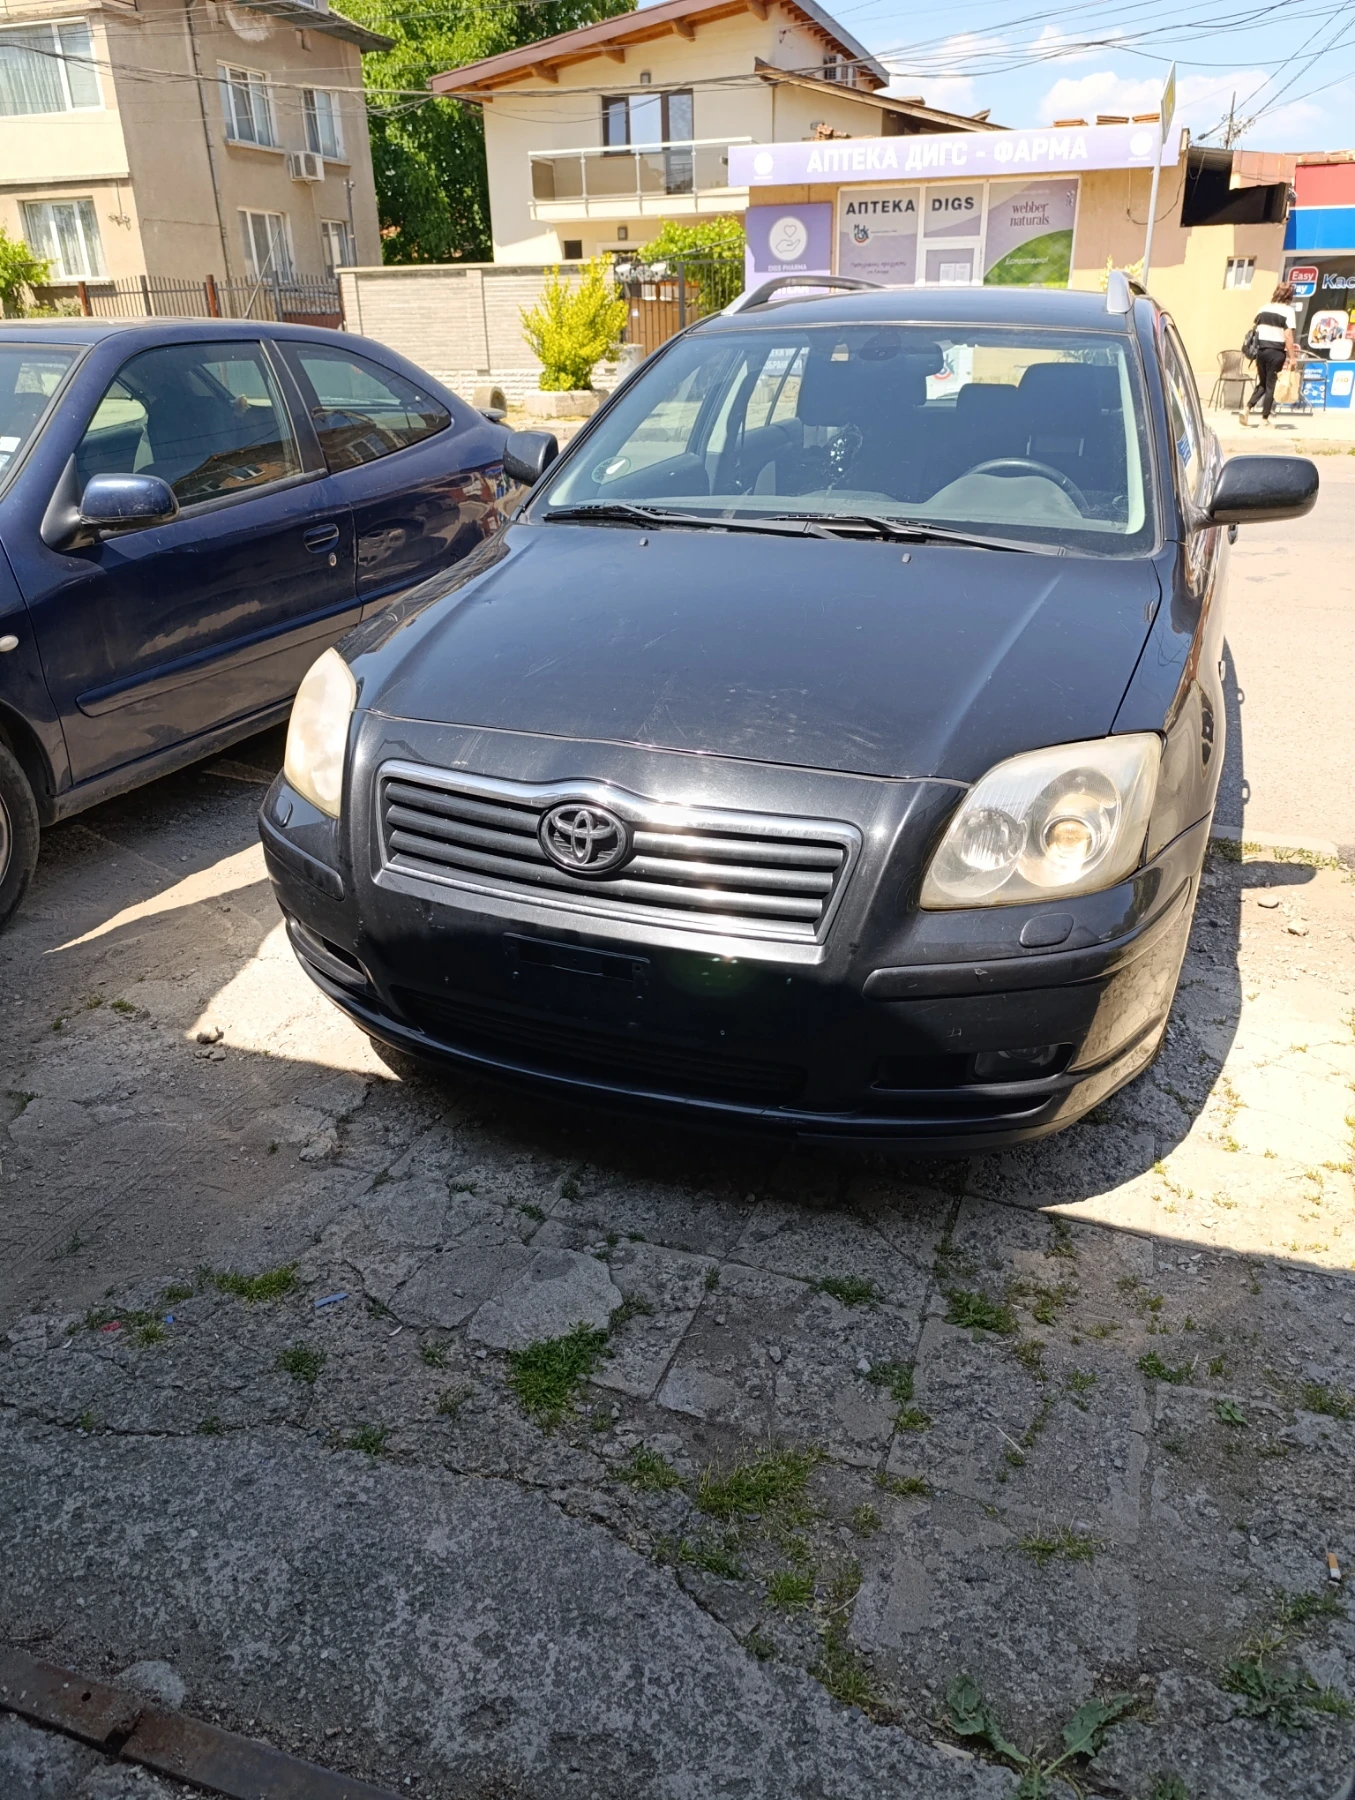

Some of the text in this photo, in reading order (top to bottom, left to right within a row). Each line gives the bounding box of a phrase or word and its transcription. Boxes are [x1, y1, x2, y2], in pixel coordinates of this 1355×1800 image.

[806, 145, 898, 173] АПТЕКА
[904, 141, 968, 171] ДИГС
[994, 136, 1088, 163] ФАРМА
[846, 197, 975, 215] АПТЕКА DIGS
[1012, 201, 1049, 214] webber
[1009, 213, 1050, 227] naturals
[1291, 271, 1315, 281] Easy
